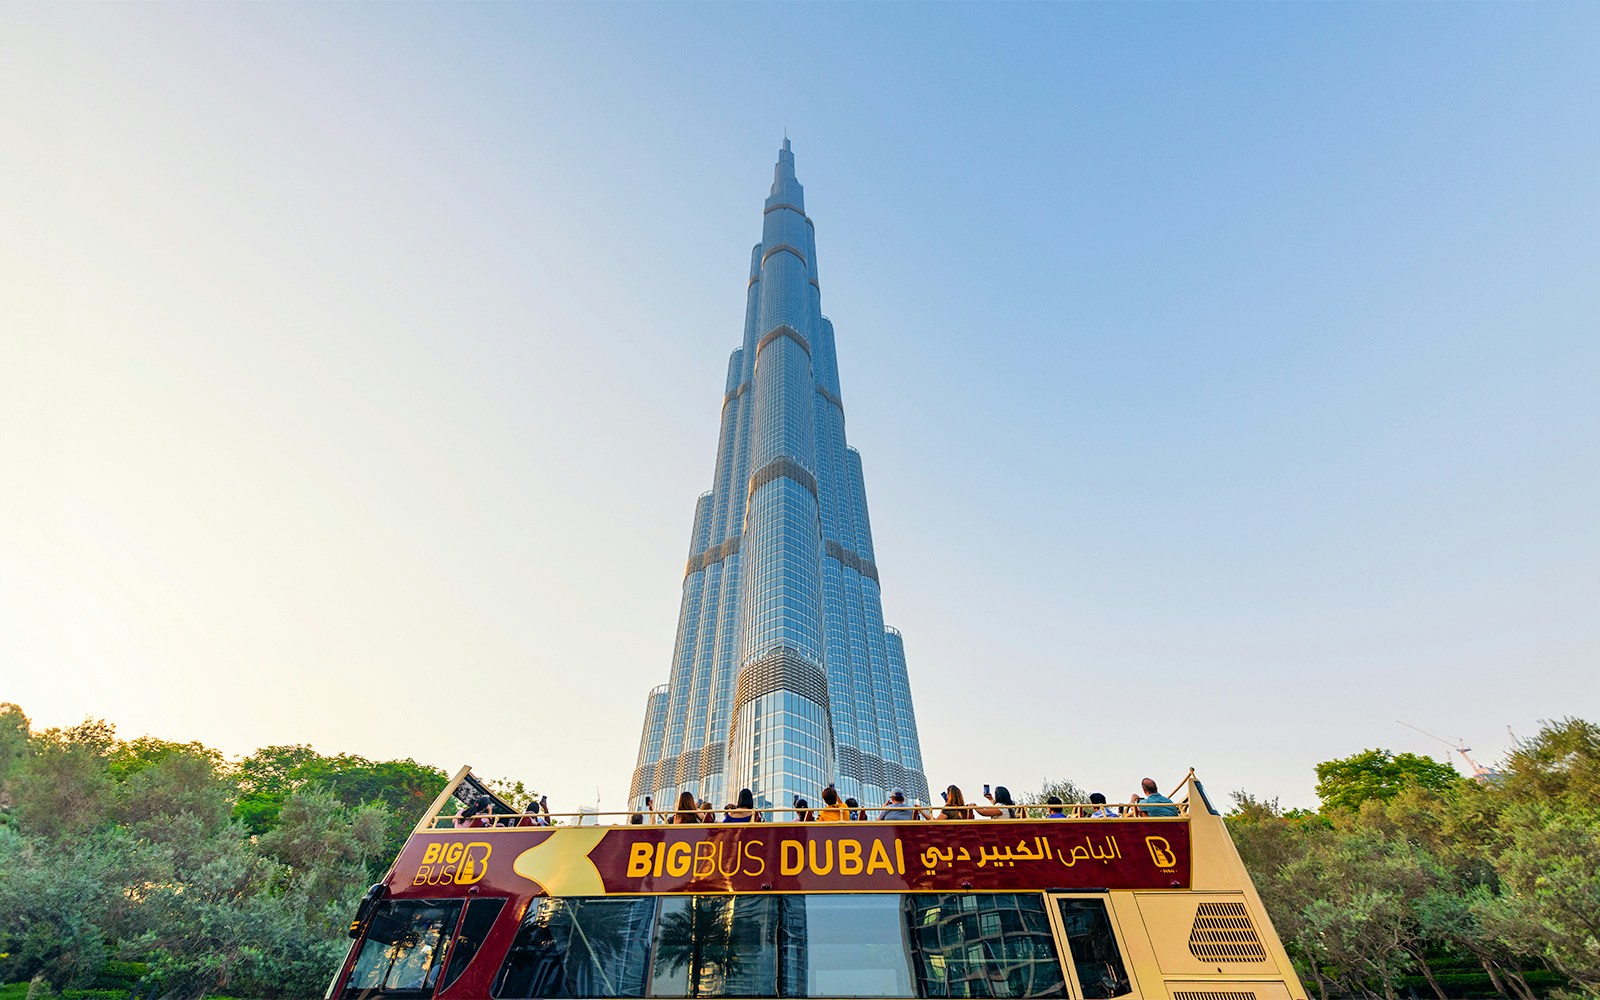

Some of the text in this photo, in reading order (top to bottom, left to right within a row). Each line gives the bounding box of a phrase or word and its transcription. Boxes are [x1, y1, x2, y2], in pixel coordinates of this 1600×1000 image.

[422, 842, 464, 865] BIG
[779, 838, 906, 876] DUBAI
[920, 835, 1122, 876] الباص الكبير دبي
[413, 865, 455, 886] BUS
